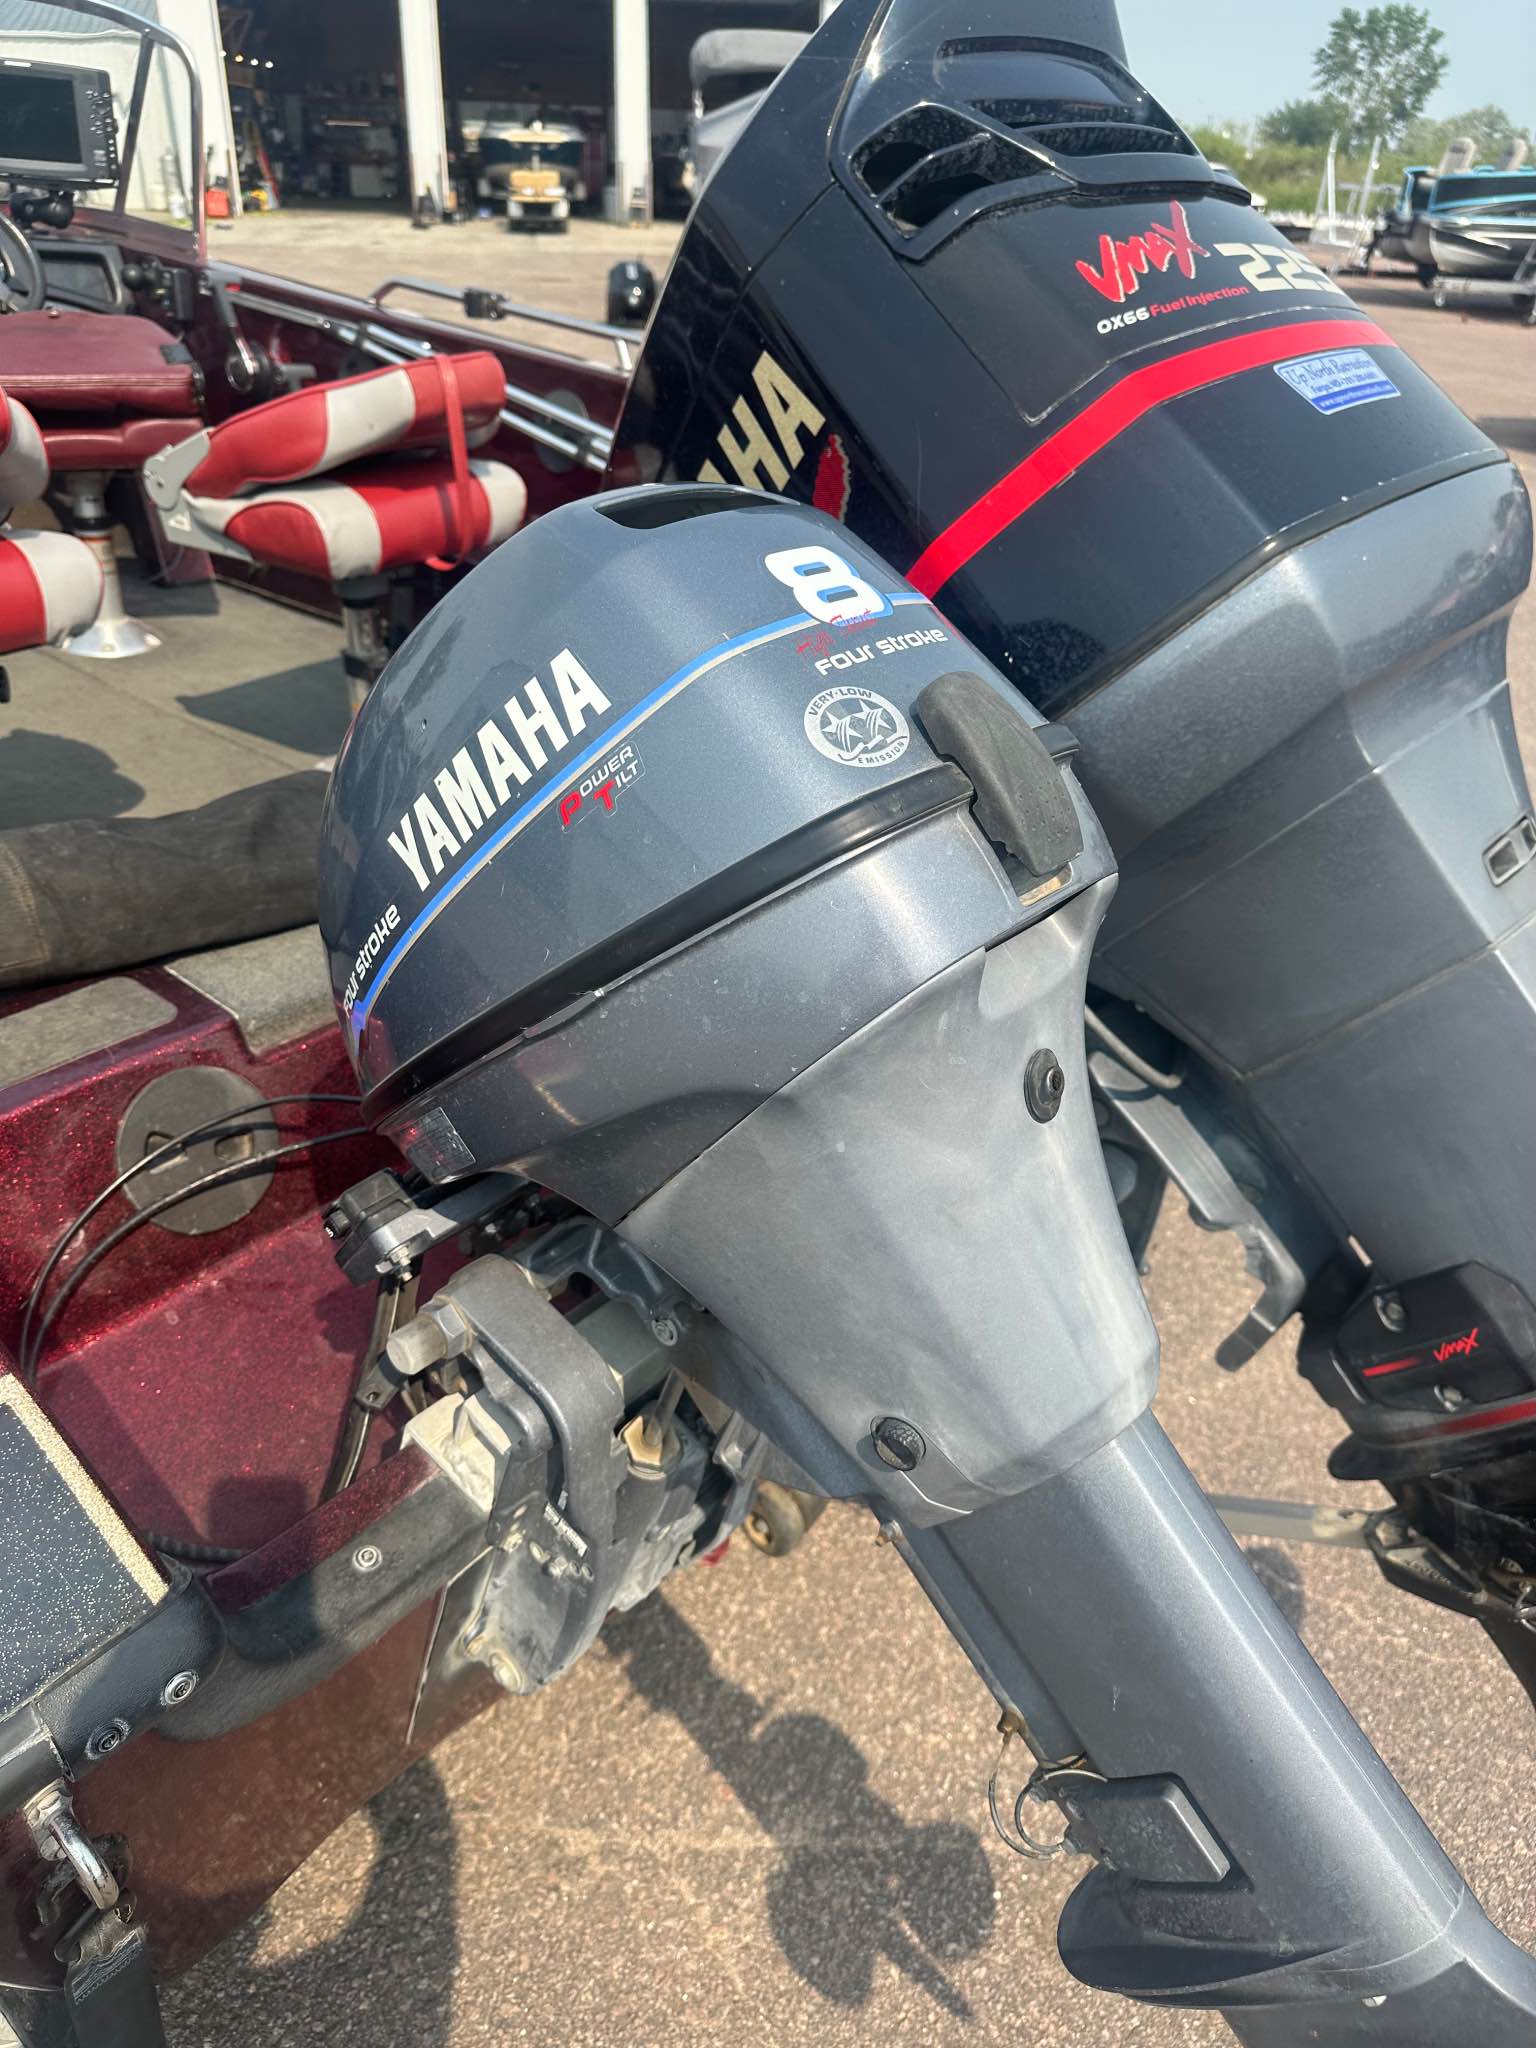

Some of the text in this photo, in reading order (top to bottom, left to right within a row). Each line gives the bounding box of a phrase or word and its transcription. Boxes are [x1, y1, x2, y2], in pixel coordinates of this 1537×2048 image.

[1150, 298, 1188, 317] Fuel
[1189, 284, 1249, 307] Injection
[764, 546, 894, 626] 8
[387, 647, 612, 892] YAMAHA
[560, 745, 634, 826] POWER
[593, 759, 638, 811] TILT
[857, 741, 905, 764] EMISSION
